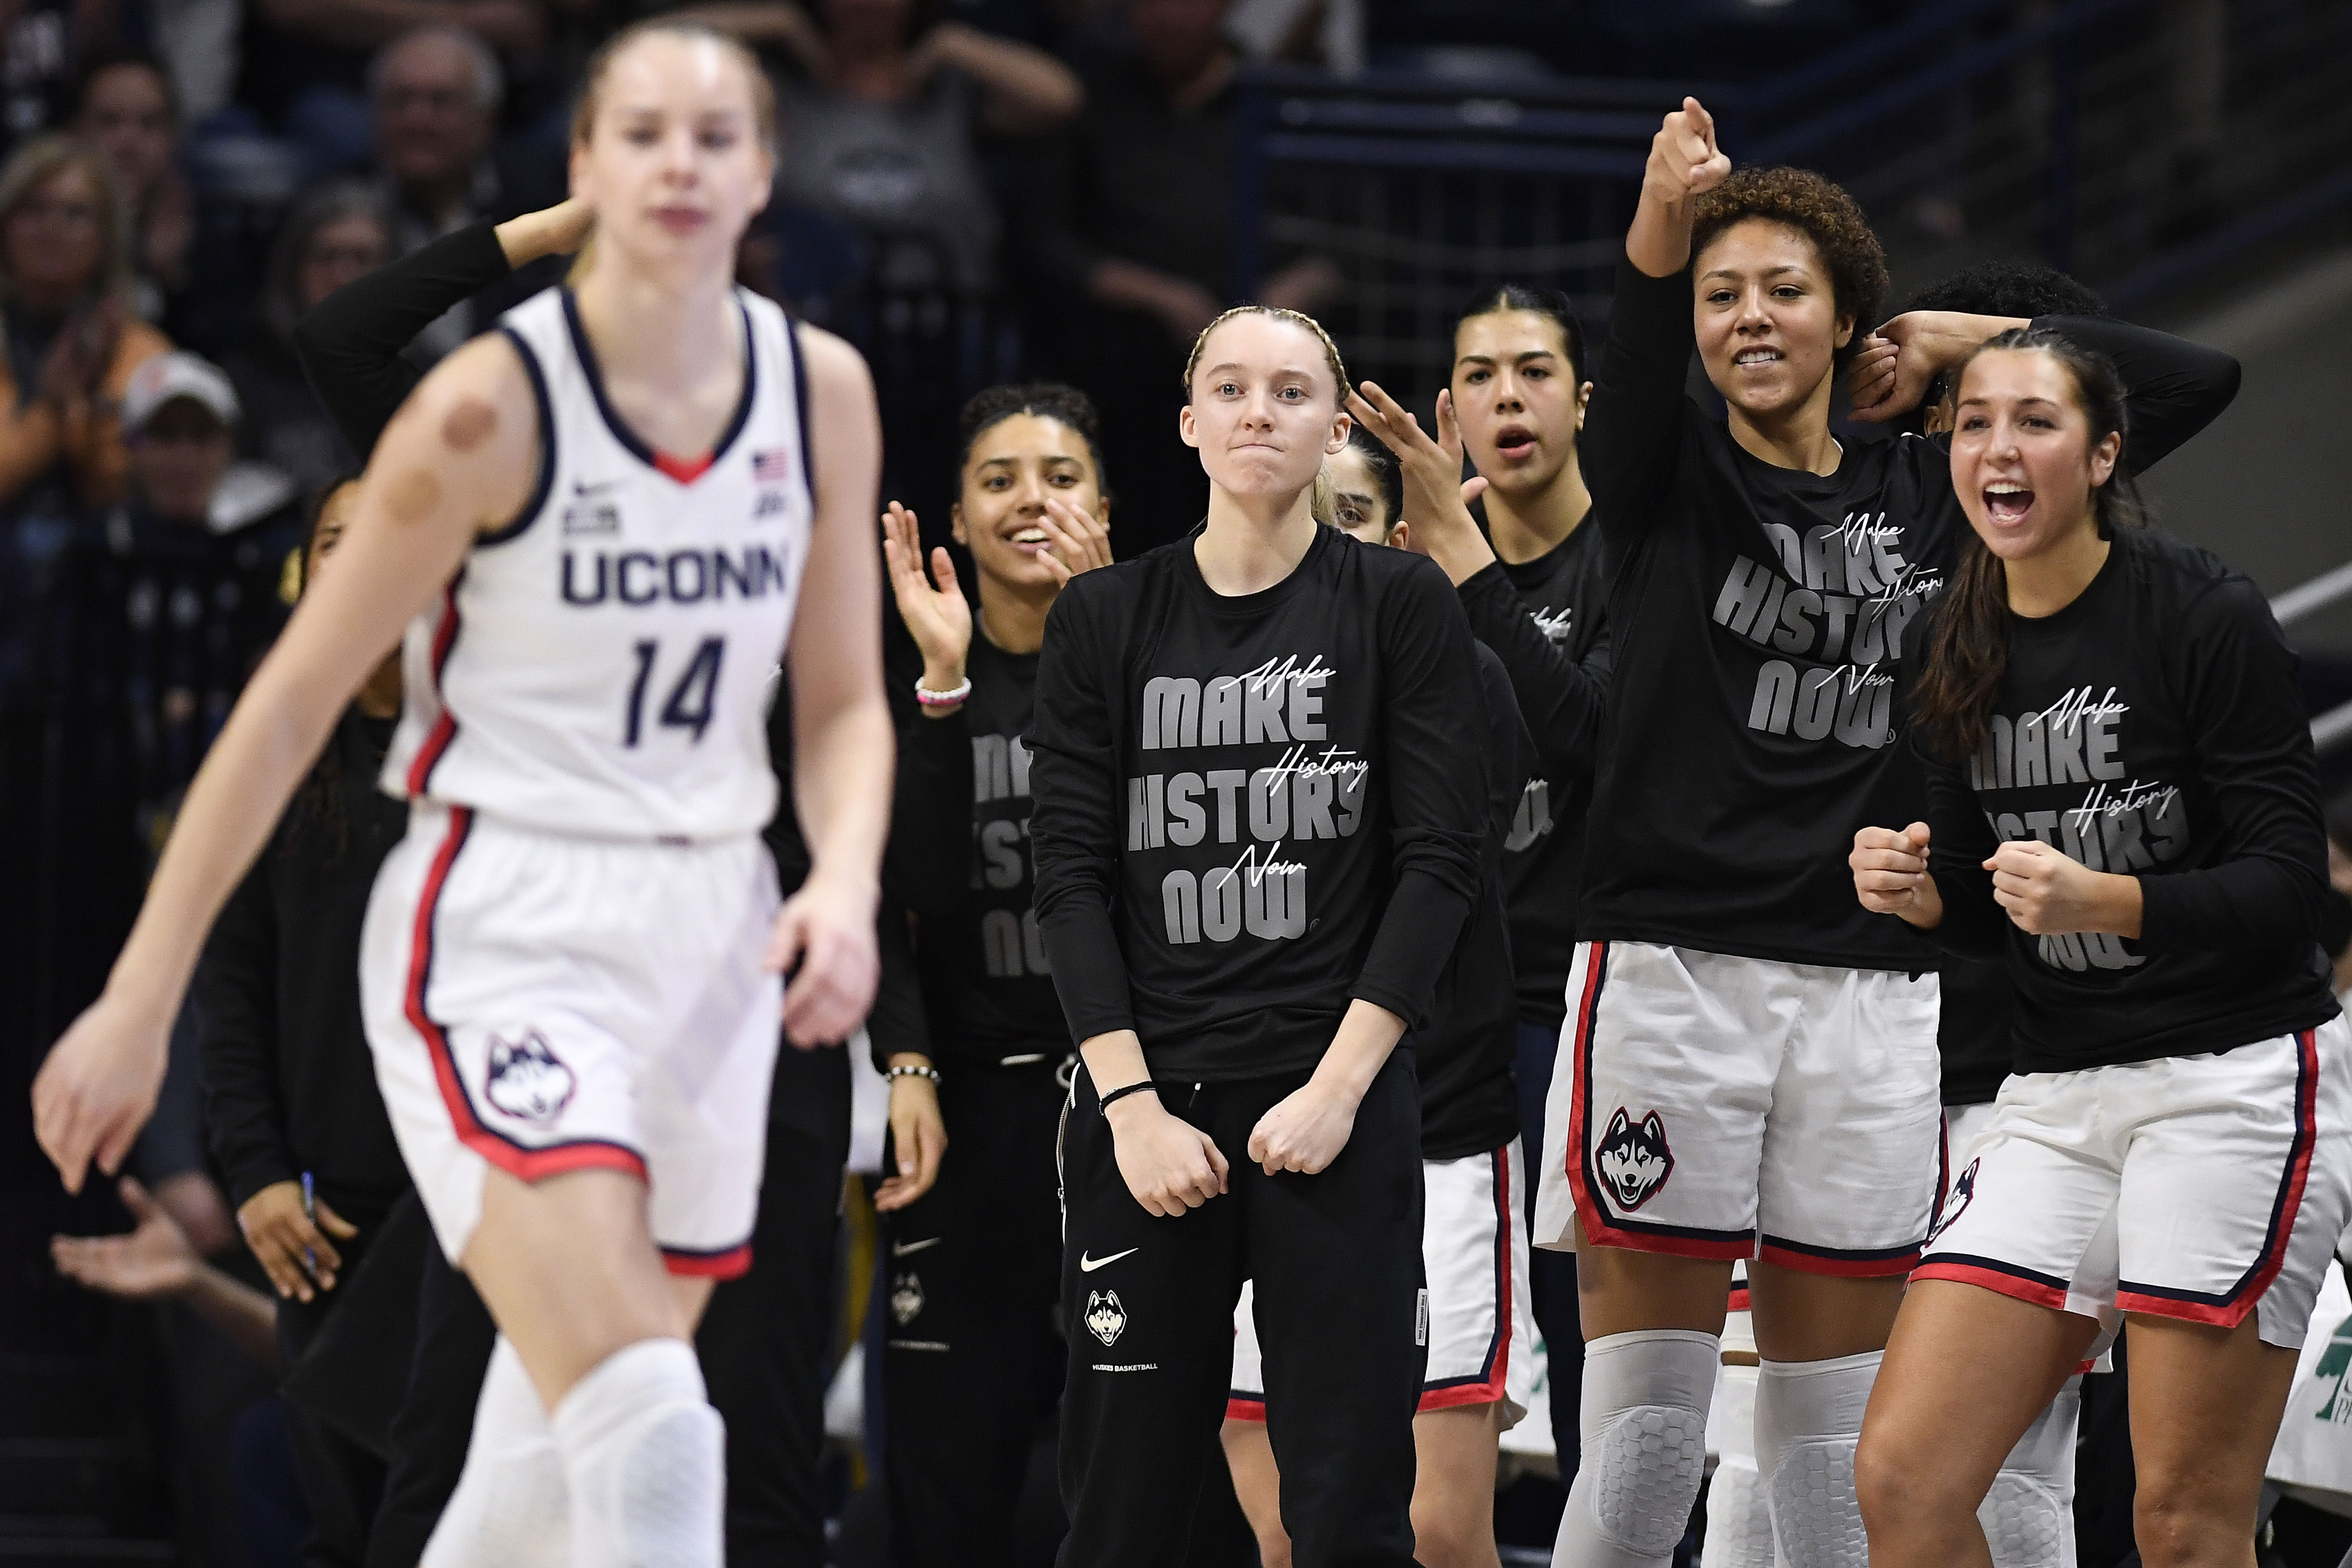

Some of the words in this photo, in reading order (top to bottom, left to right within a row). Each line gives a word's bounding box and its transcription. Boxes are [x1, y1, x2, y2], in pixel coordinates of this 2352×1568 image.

[561, 545, 787, 607] UCONN
[1712, 554, 1939, 665] HISTOR
[622, 634, 727, 750] 14
[1219, 654, 1337, 698] Make
[1747, 659, 1892, 749] NOW
[1814, 663, 1895, 695] Now
[1142, 675, 1327, 750] MAKE
[2027, 685, 2130, 737] Make
[1260, 743, 1369, 797] History
[1128, 766, 1369, 852] HISTORY
[2068, 779, 2179, 837] History
[1216, 841, 1307, 889] Now
[1162, 866, 1306, 944] NOW
[1114, 1362, 1159, 1372] BASKETBALL
